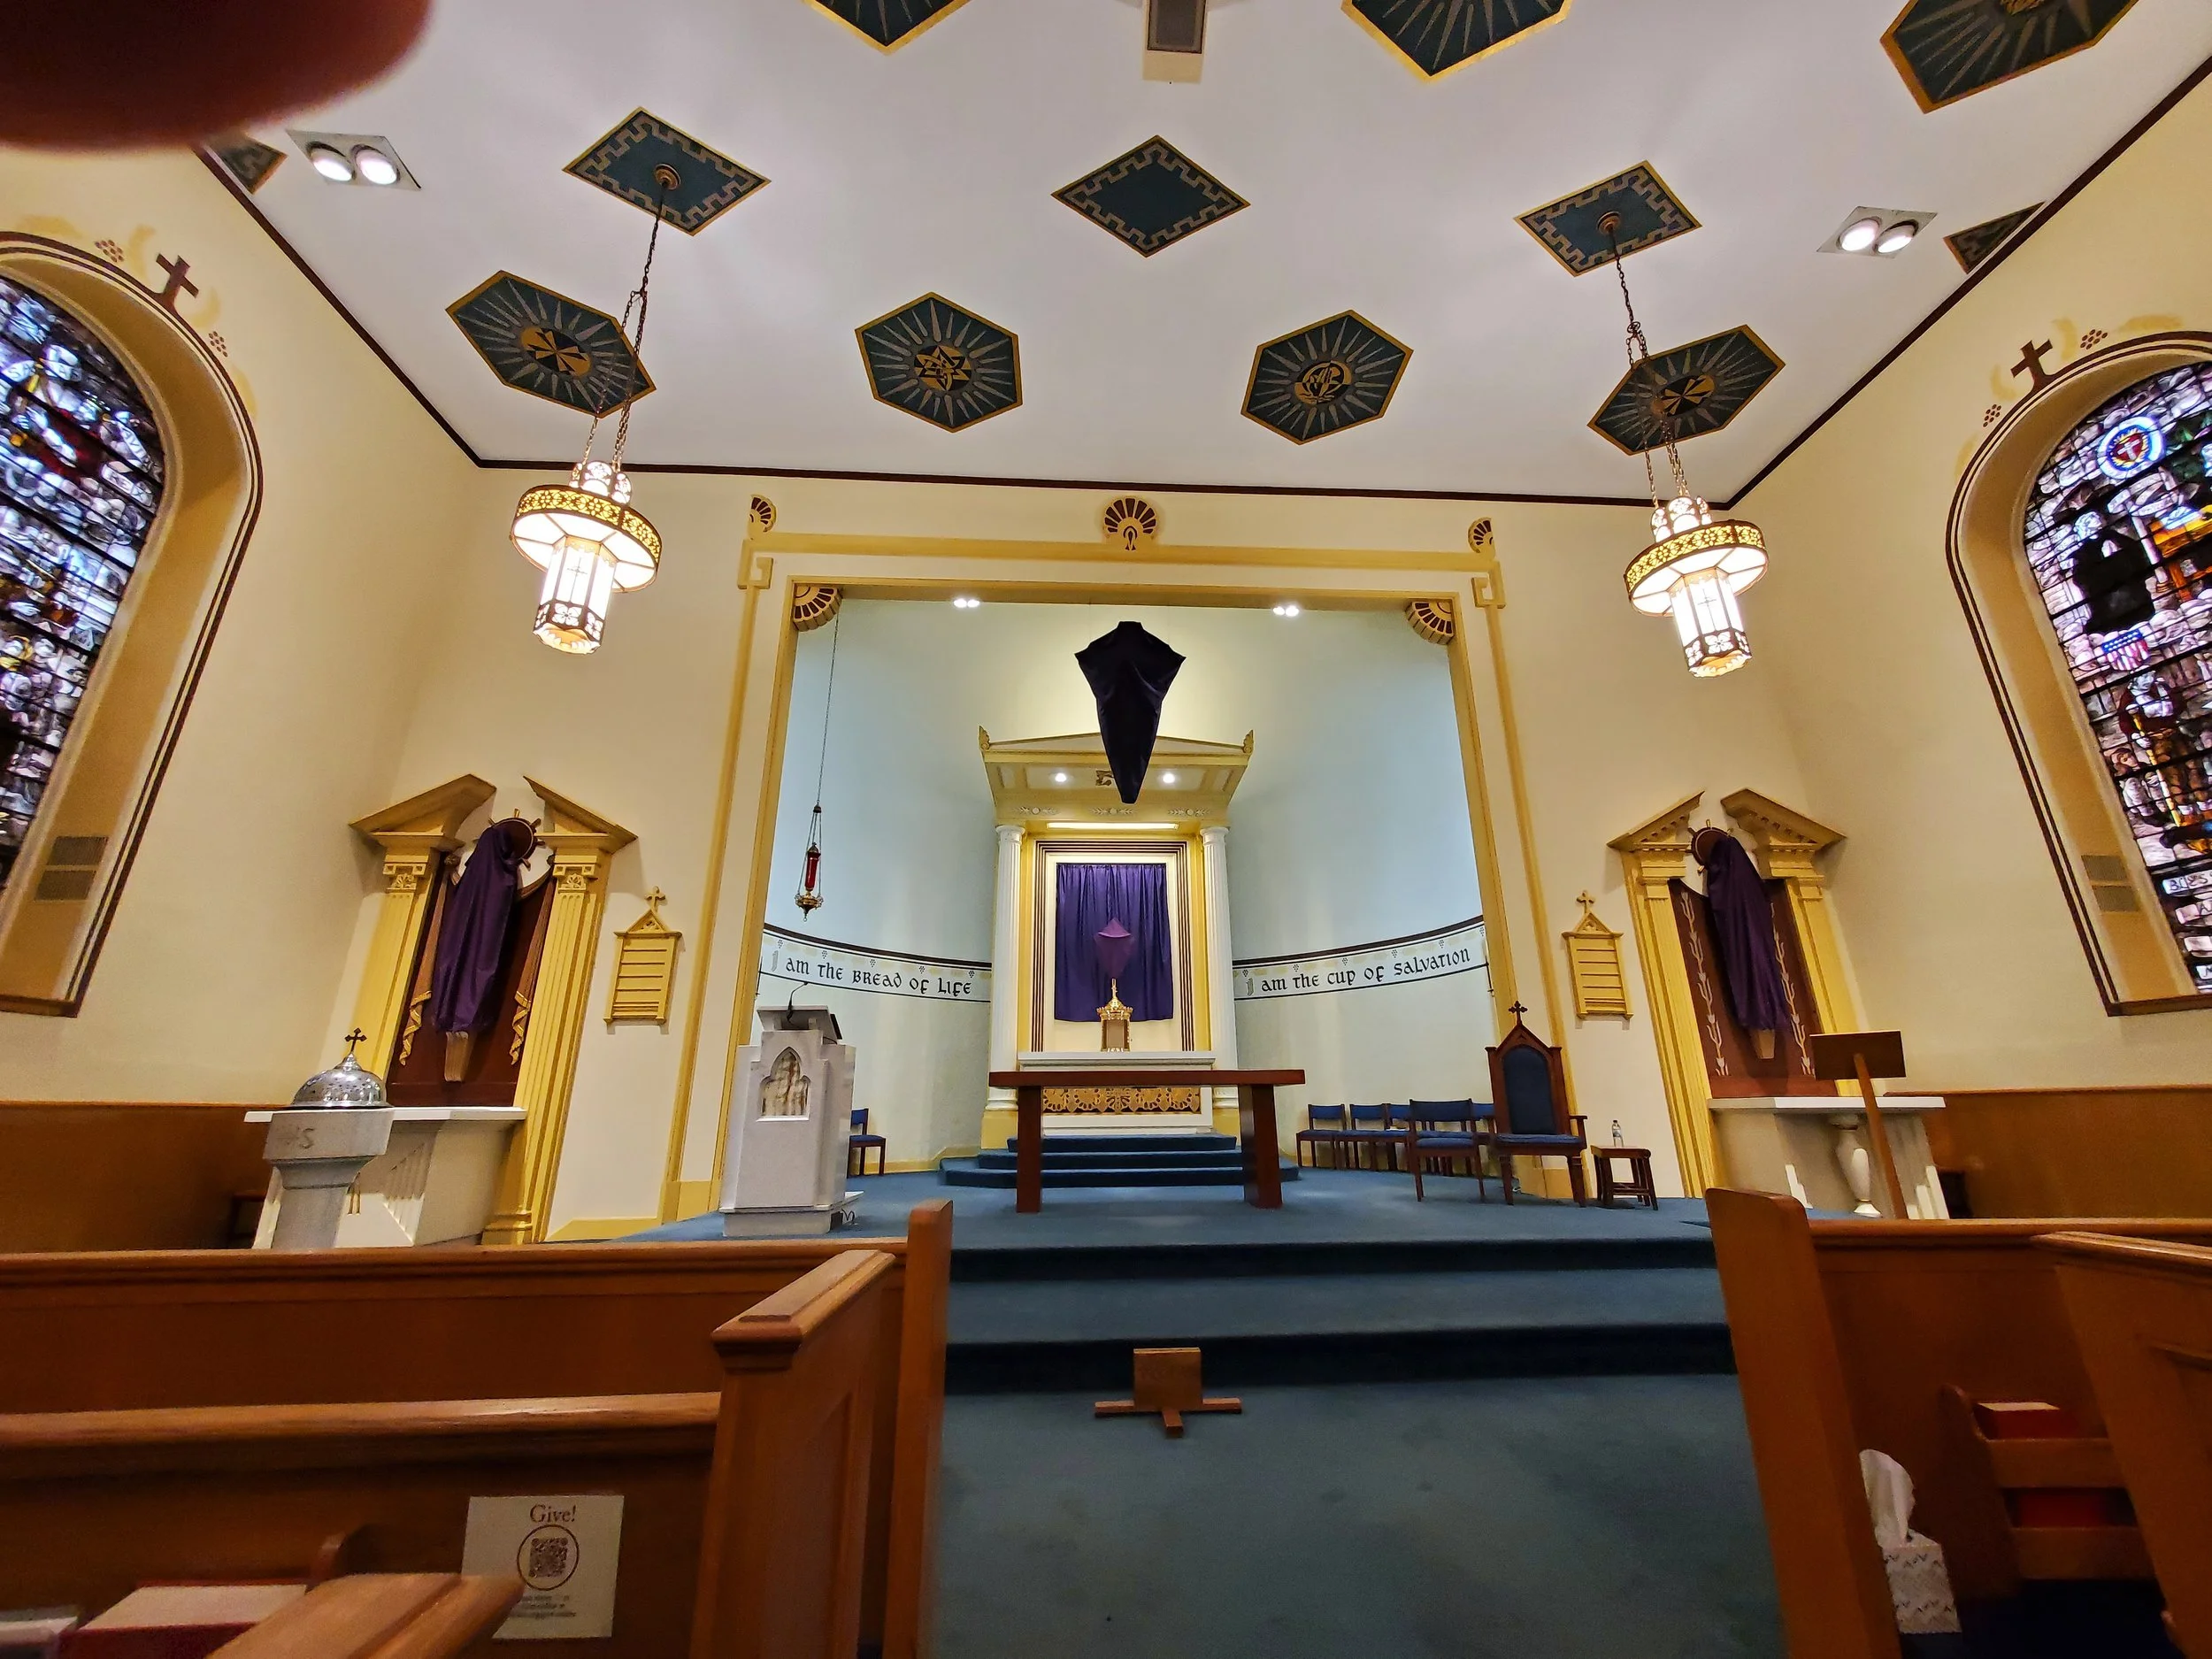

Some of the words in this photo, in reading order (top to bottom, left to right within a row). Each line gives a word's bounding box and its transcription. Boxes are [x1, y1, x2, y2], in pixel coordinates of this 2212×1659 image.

[786, 957, 810, 975] am
[1261, 978, 1287, 992] am
[530, 1504, 577, 1523] Give!
